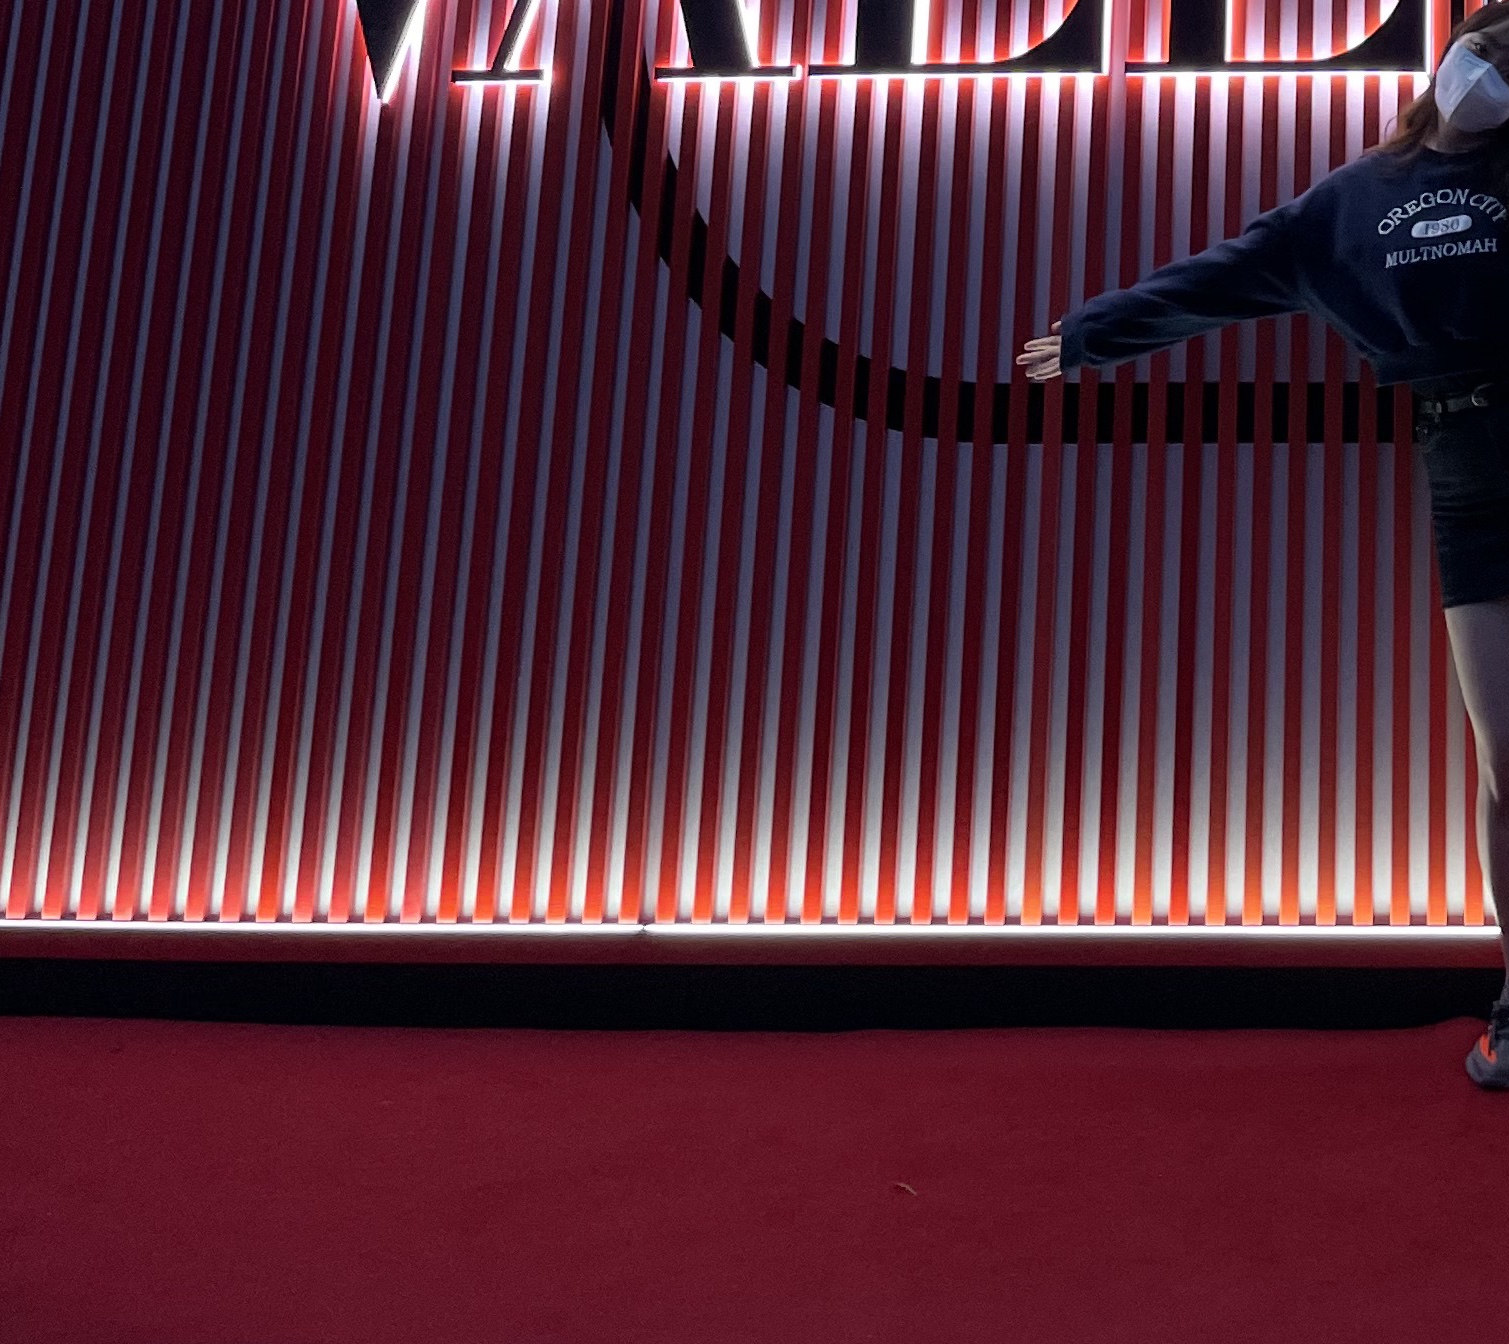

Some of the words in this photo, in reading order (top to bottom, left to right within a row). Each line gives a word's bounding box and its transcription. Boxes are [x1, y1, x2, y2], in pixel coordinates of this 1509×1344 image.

[1377, 188, 1470, 235] OREGON
[1469, 193, 1508, 223] CITY
[1384, 238, 1498, 268] MULTNOMAH
